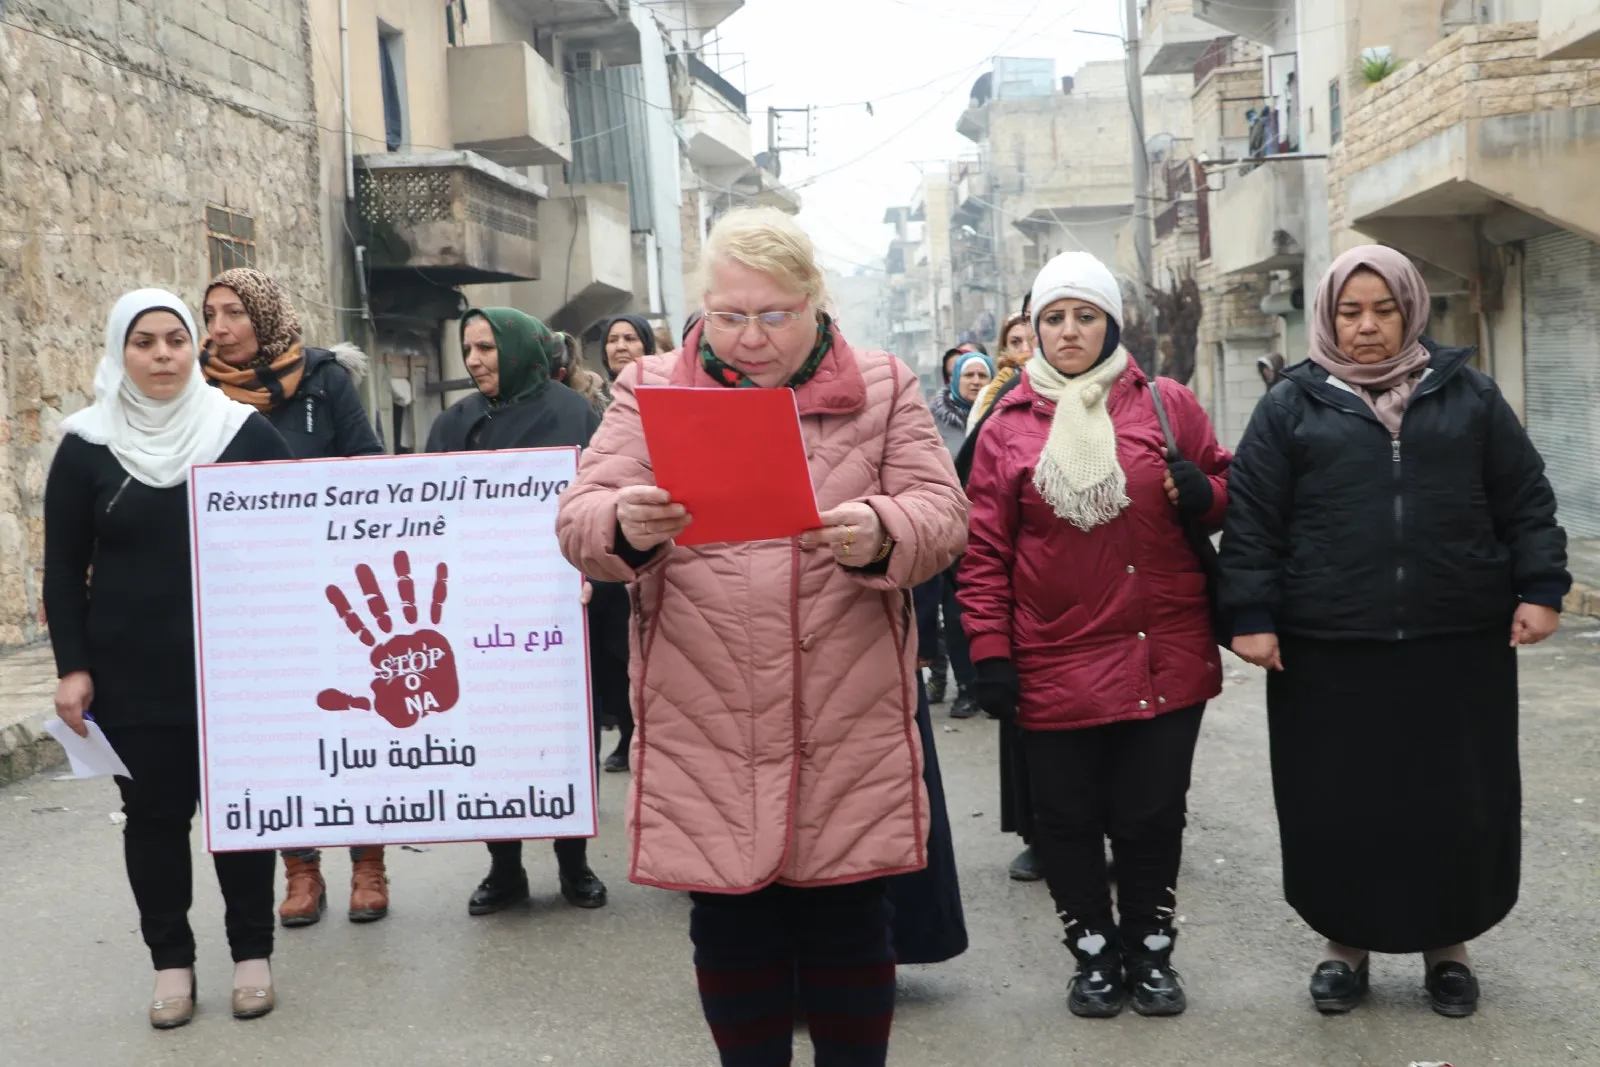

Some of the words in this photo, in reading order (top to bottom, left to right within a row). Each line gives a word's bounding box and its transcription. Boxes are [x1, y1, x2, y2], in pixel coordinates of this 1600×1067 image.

[325, 486, 379, 507] Sara
[386, 482, 414, 503] Ya
[353, 518, 393, 540] Ser
[473, 624, 515, 654] حلب
[524, 625, 564, 652] فرع
[380, 647, 445, 680] STOP
[404, 691, 440, 716] NA
[318, 738, 376, 777] سارا
[388, 734, 476, 769] منظمة
[226, 788, 303, 837] المرأة
[314, 798, 354, 826] ضد
[365, 786, 446, 824] العنف
[456, 783, 575, 820] لمناهضة
